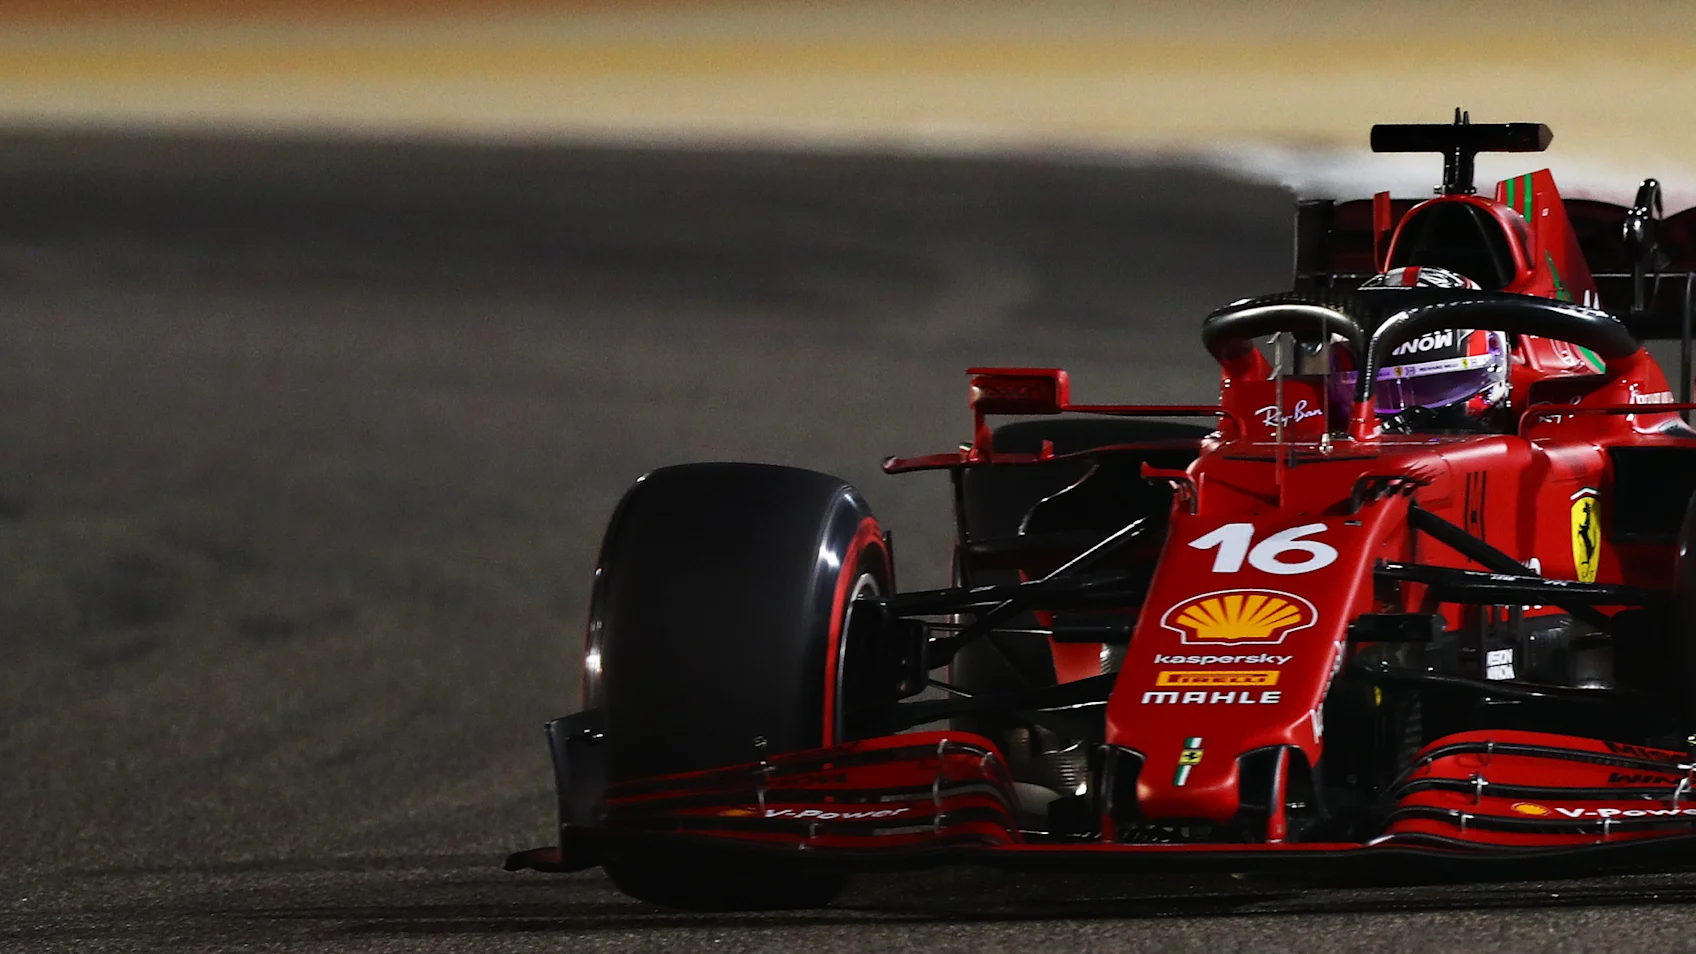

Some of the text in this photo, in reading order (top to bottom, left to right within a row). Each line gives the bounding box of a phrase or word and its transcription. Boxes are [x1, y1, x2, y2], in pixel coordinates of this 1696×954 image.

[1187, 523, 1338, 575] 16
[1153, 653, 1293, 666] kaspersky
[1141, 691, 1283, 705] MAHLE
[764, 807, 912, 820] V-Power
